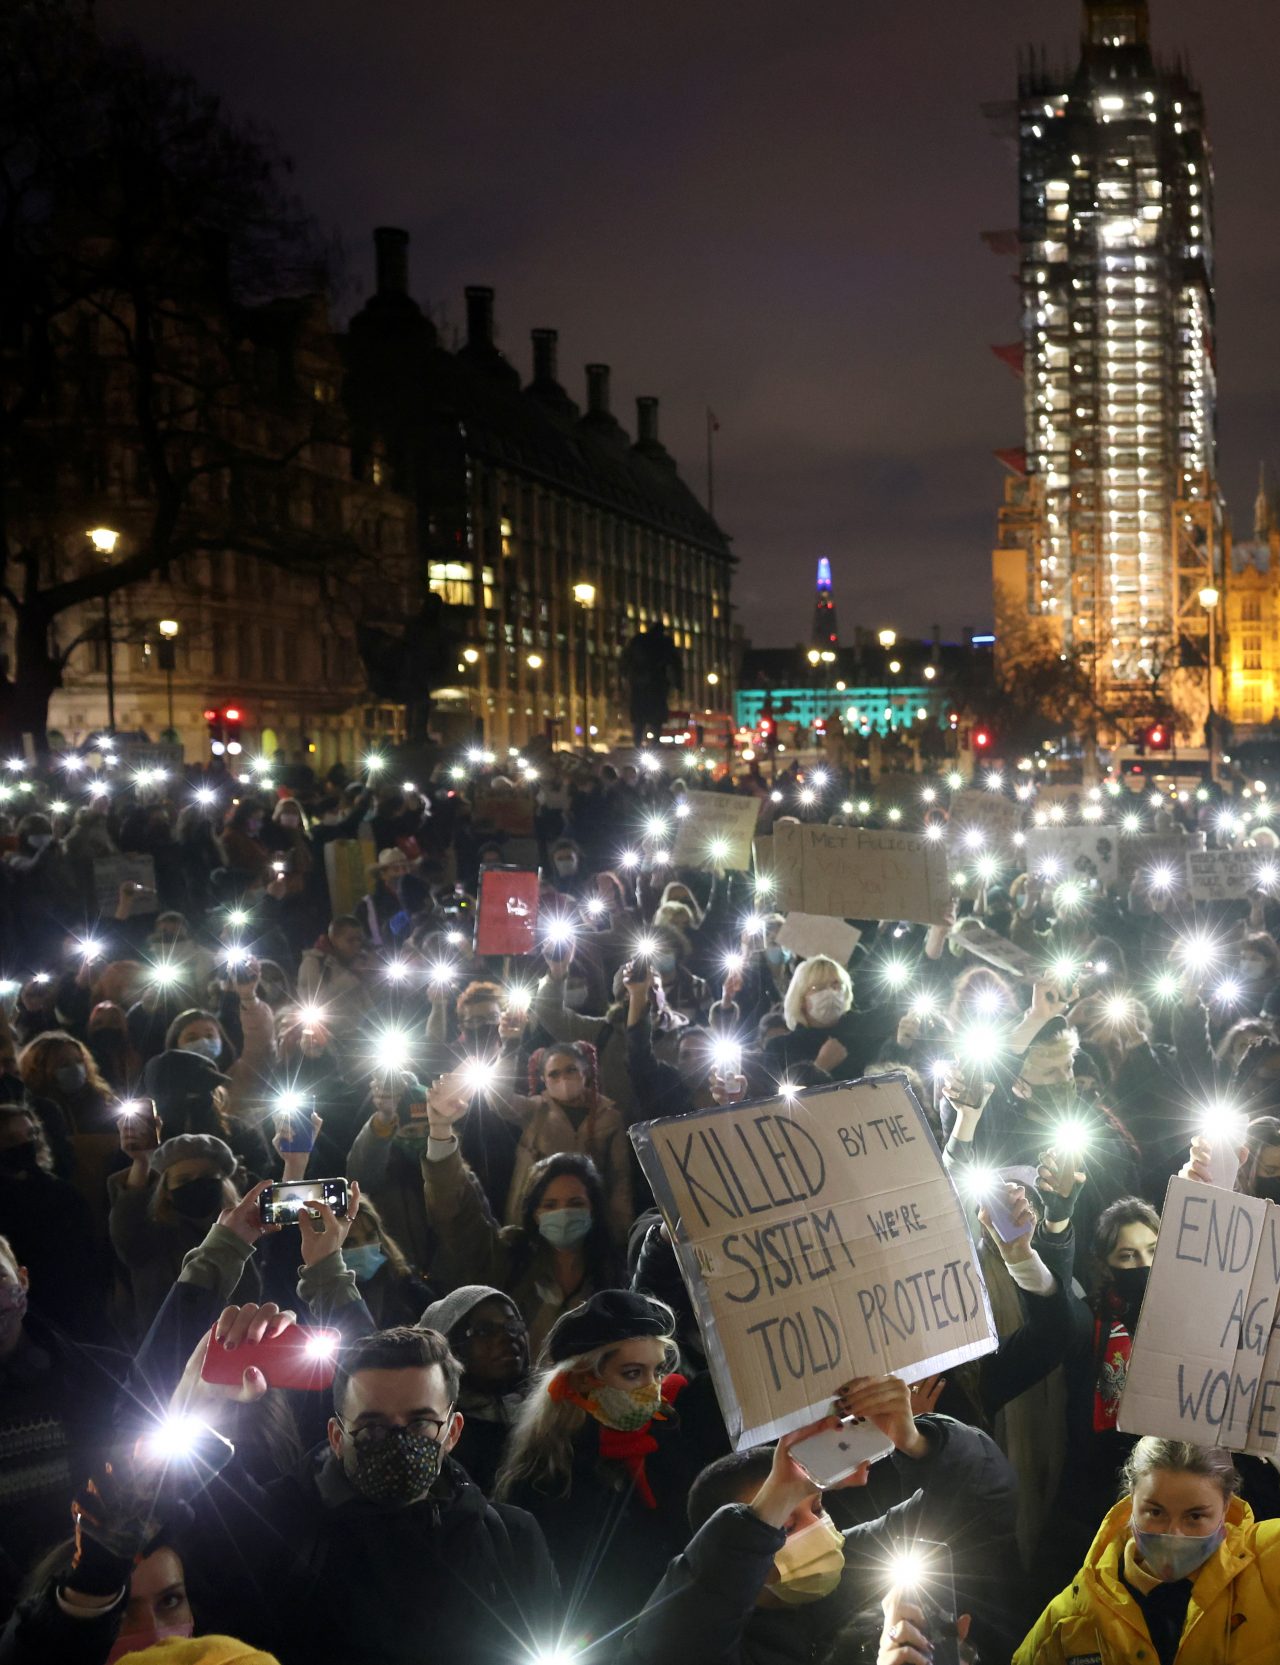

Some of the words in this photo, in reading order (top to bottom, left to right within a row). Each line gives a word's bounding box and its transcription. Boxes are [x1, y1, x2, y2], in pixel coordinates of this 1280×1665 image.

[666, 1114, 826, 1228] KILLED
[838, 1124, 868, 1159] BY
[867, 1114, 915, 1147] THE
[722, 1208, 856, 1303] SYSTEM
[867, 1202, 927, 1244] WE'RE
[1176, 1195, 1254, 1274] END
[746, 1305, 842, 1392] TOLD
[857, 1259, 980, 1356] PROTECTS
